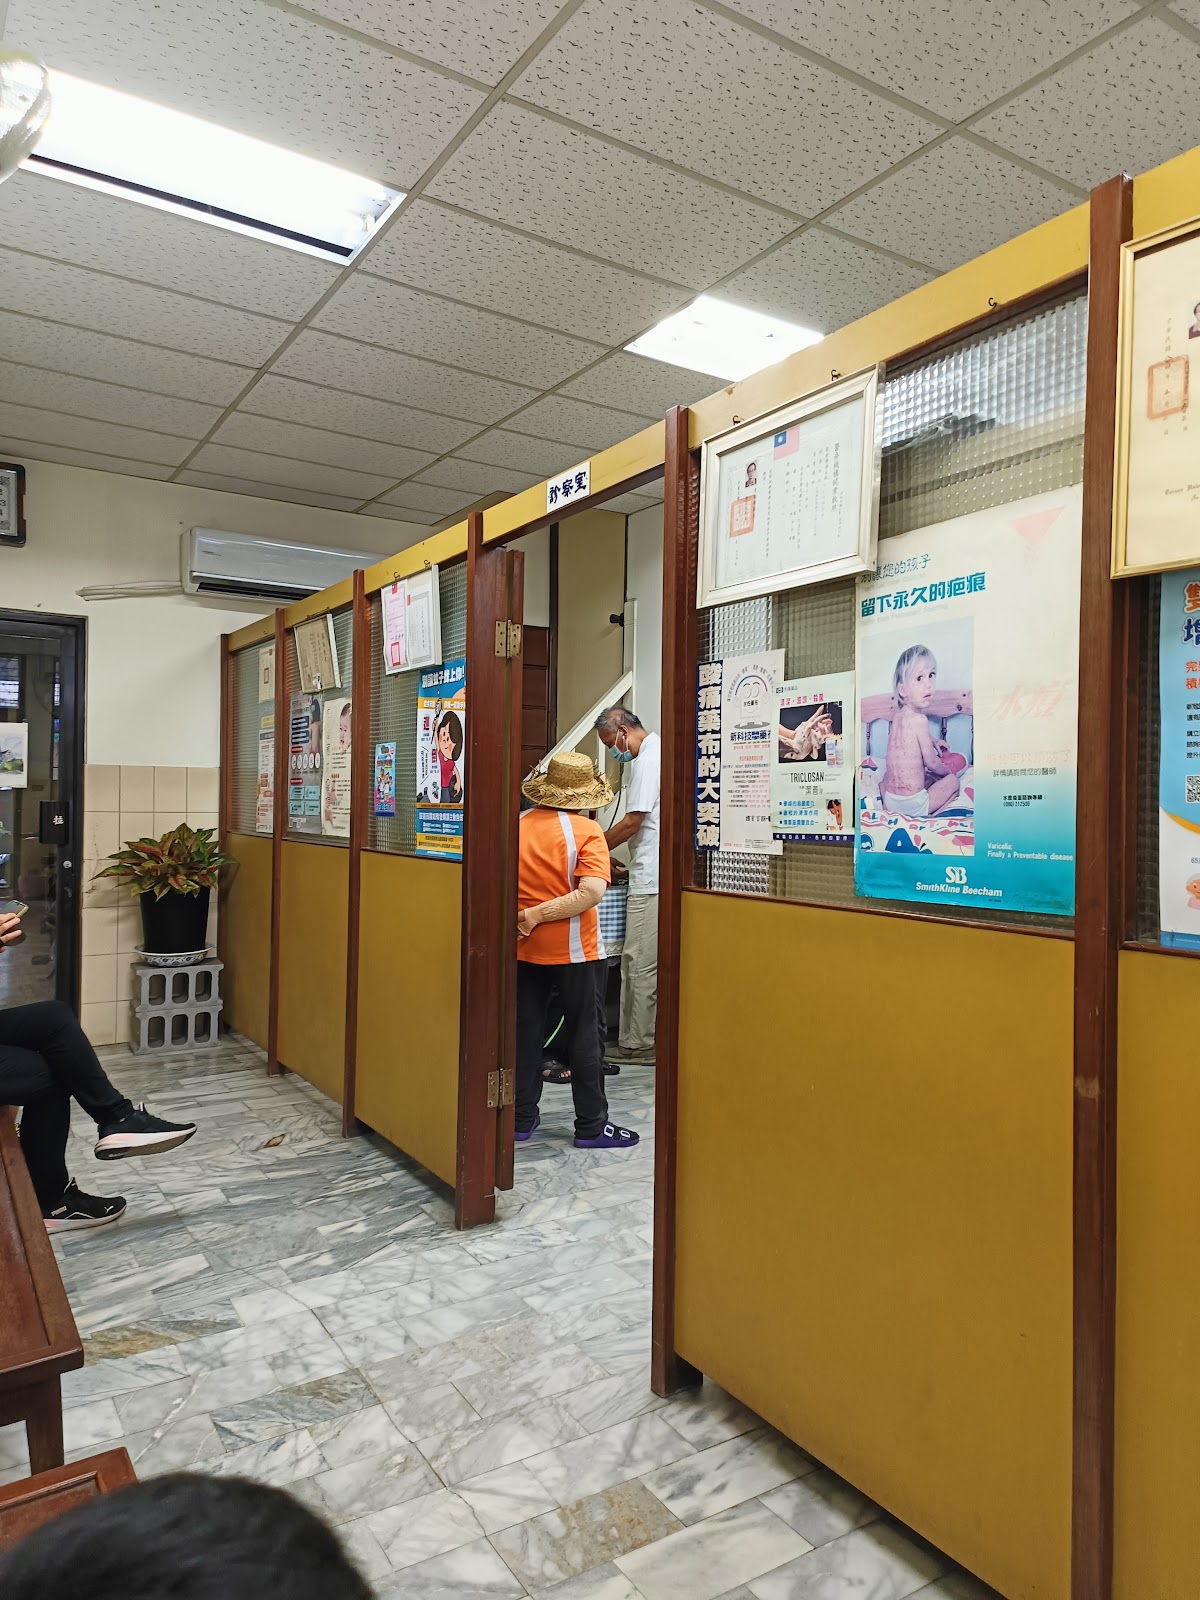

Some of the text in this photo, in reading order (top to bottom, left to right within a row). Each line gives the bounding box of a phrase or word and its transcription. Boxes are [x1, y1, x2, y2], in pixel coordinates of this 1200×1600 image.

[861, 571, 986, 618] 留下永久的疤痕
[697, 663, 722, 847] 酸痛藥布的大突破
[790, 771, 825, 783] TRICLOSAN
[987, 850, 1005, 858] Finally
[1013, 852, 1047, 860] Preventable
[1050, 853, 1073, 861] disease
[945, 866, 967, 884] SB
[916, 882, 1003, 897] SmithKline Beecham
